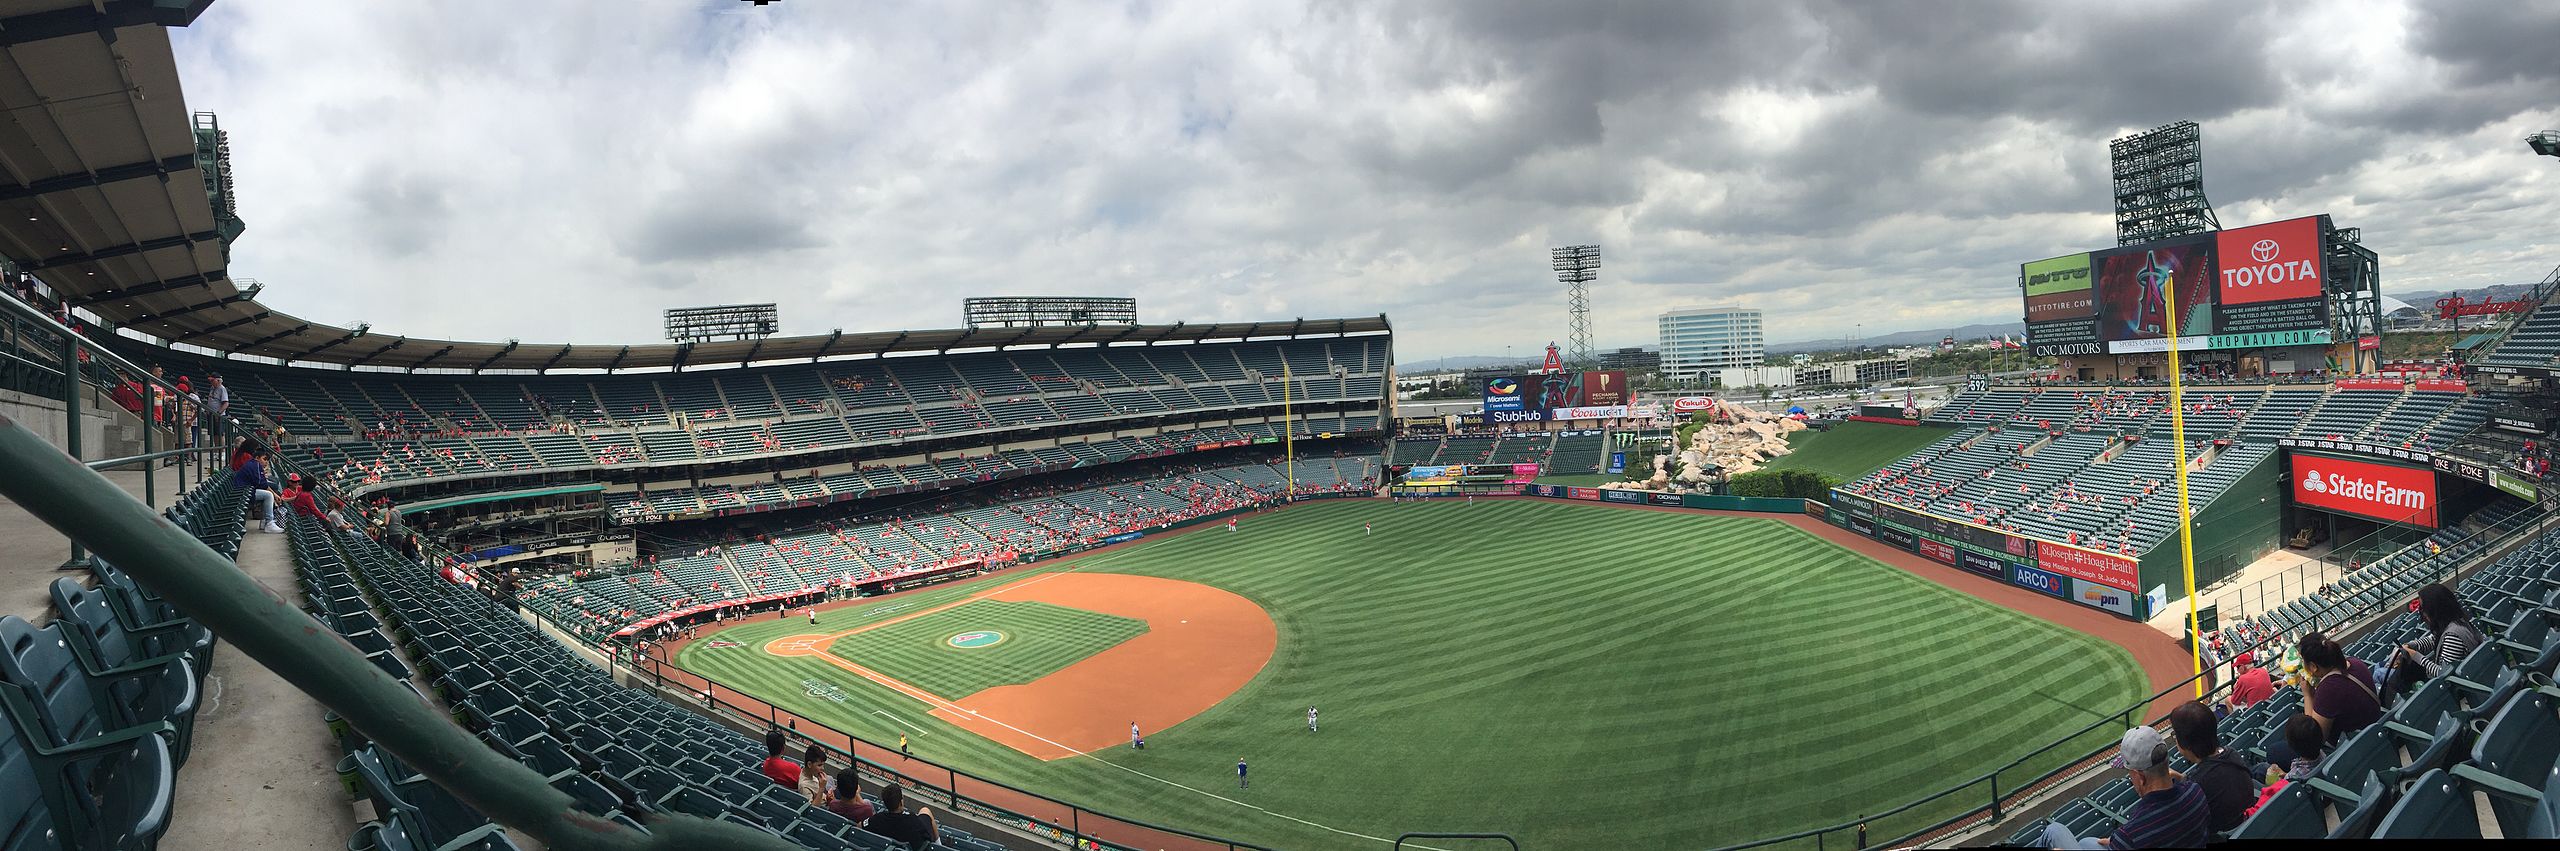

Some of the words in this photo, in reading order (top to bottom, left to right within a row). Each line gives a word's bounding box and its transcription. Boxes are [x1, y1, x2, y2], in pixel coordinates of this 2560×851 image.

[2029, 267, 2090, 286] NITTO
[2223, 260, 2317, 288] TOYOTA
[2029, 299, 2092, 313] NITTOTIRE.COM
[2209, 331, 2310, 348] SHOPWAVY.COM
[2036, 344, 2057, 357] CNC
[2059, 342, 2101, 355] MOTORS
[1970, 380, 1985, 391] 592
[1494, 410, 1541, 422] StubHub
[1570, 408, 1598, 418] Coors
[2461, 464, 2483, 478] POKE
[1838, 494, 1853, 504] KONICA
[1854, 499, 1872, 510] MINOLTA
[2052, 562, 2070, 572] Mission
[2083, 554, 2105, 572] Hoag
[2106, 558, 2134, 576] Health
[2017, 569, 2048, 589] ARCO
